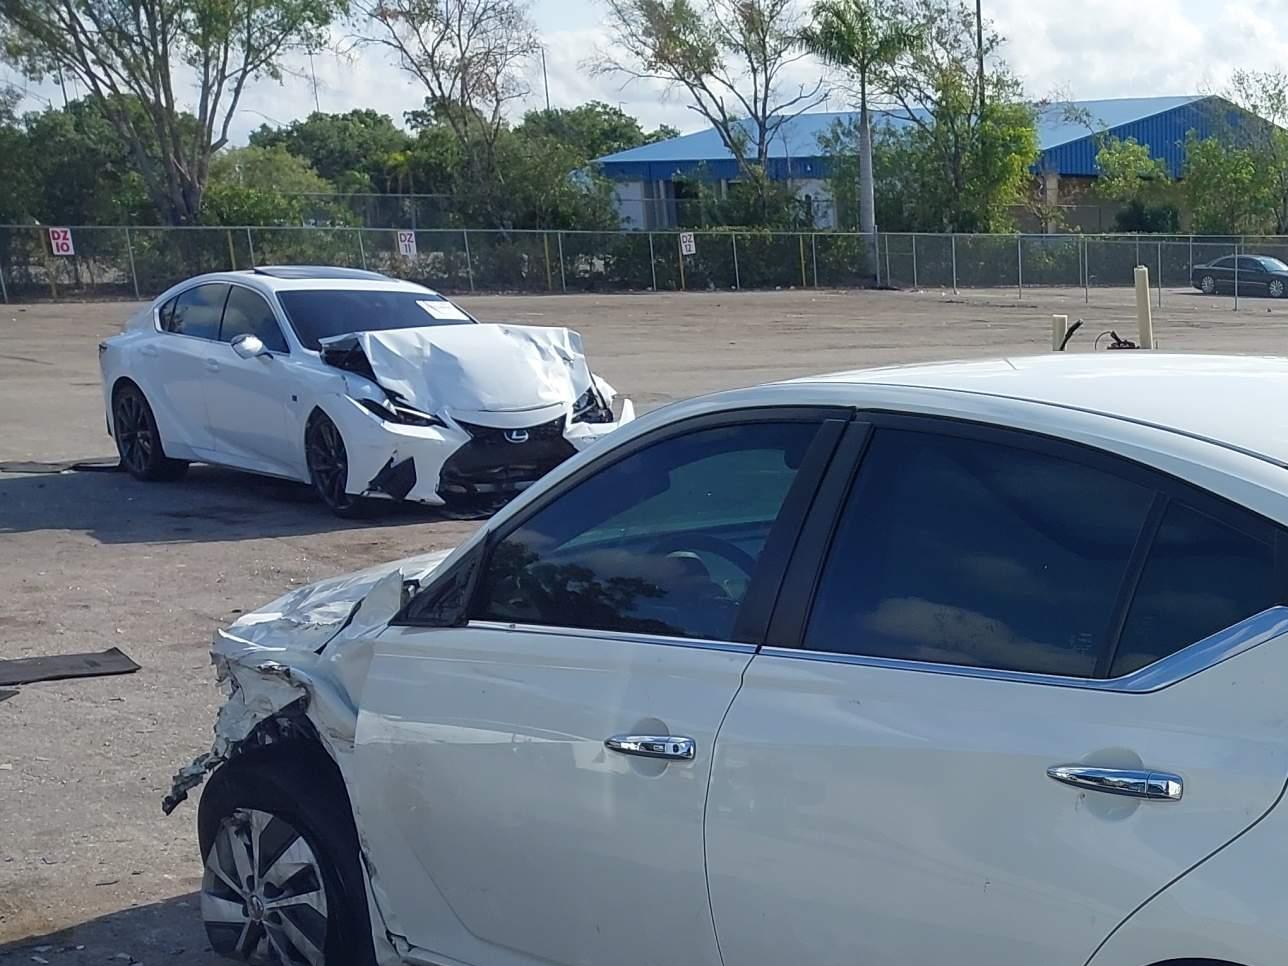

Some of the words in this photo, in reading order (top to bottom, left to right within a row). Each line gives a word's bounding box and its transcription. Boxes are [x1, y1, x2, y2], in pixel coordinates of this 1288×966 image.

[51, 230, 69, 241] DZ
[400, 232, 414, 243] DZ
[681, 234, 693, 244] DZ
[56, 242, 70, 252] 10
[404, 243, 411, 254] 11
